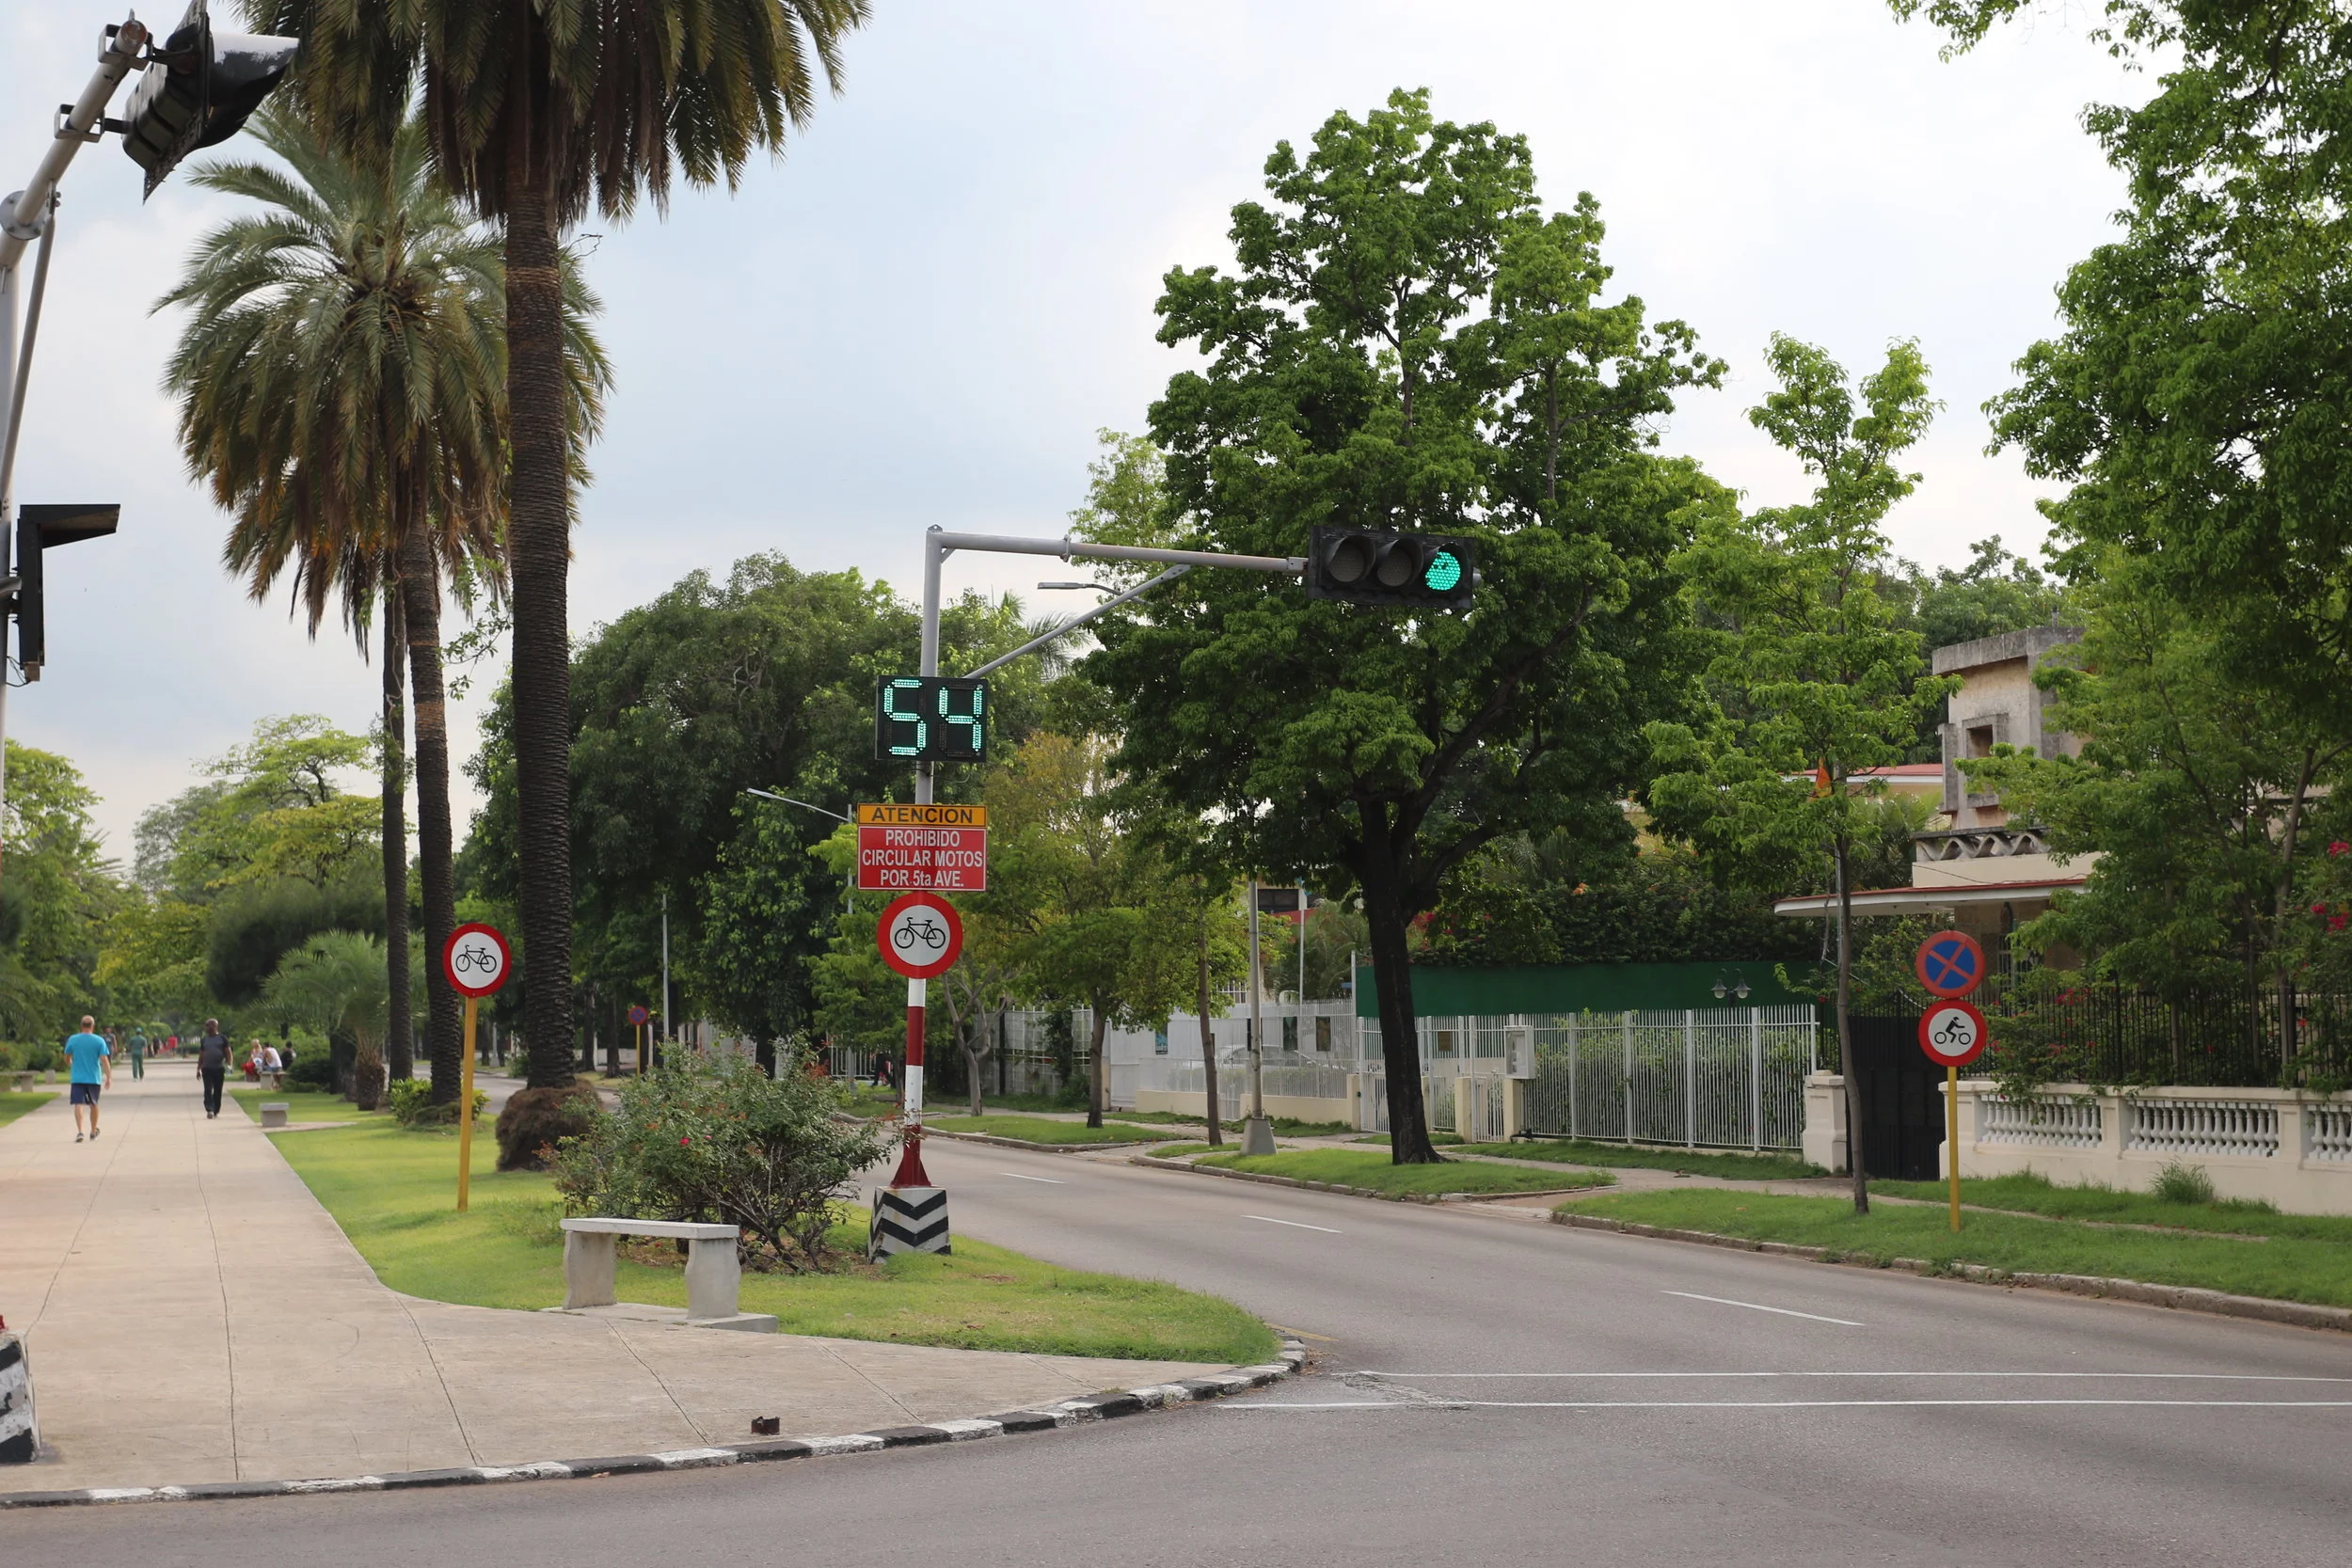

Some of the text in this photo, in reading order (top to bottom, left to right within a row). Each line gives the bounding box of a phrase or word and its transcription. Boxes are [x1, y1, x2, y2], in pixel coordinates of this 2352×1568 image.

[883, 679, 983, 756] 54
[872, 807, 973, 823] ATENCION
[885, 830, 960, 847] PROHIBIDO
[862, 849, 982, 867] CIRCULAR MOTOS
[881, 870, 963, 887] POR 5ta AVE.
